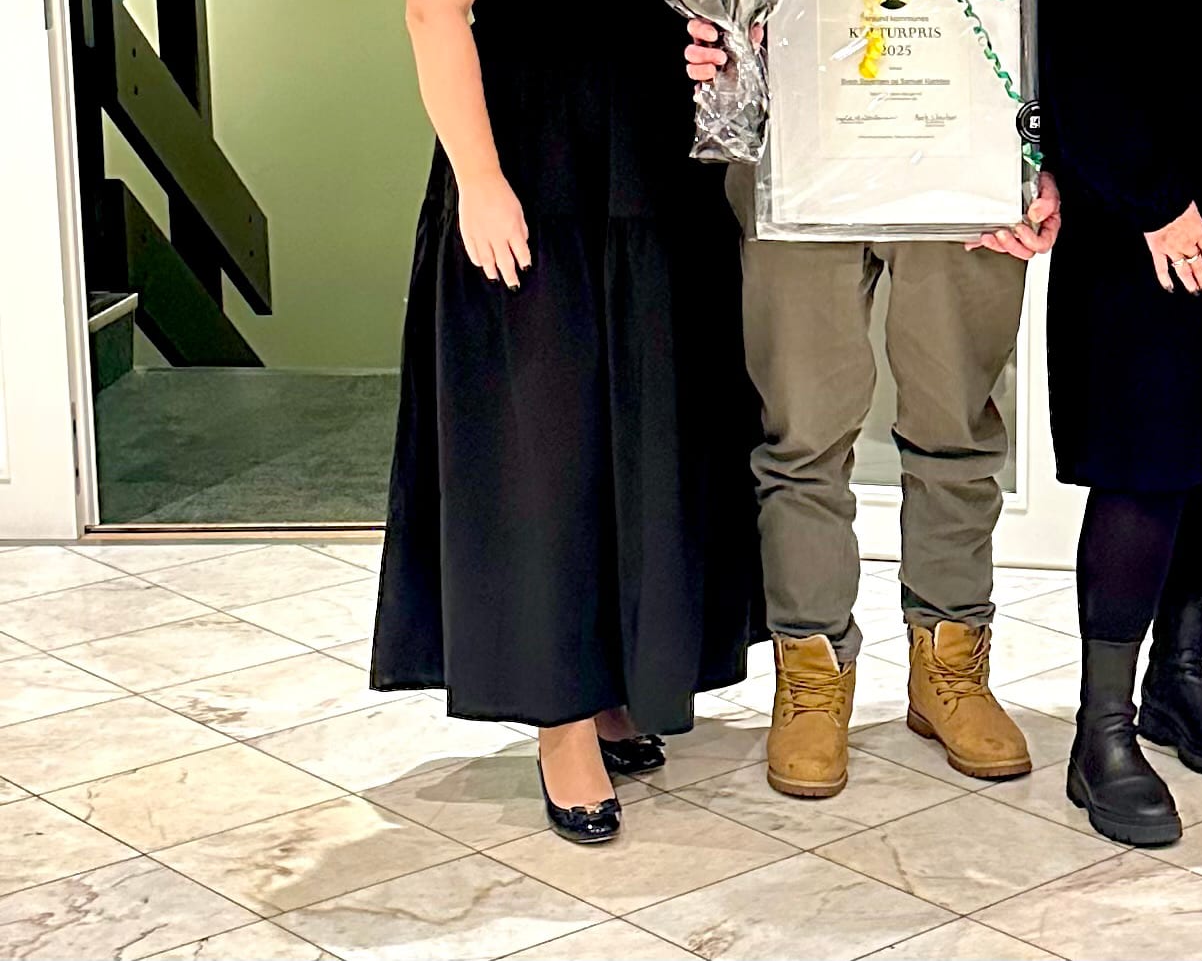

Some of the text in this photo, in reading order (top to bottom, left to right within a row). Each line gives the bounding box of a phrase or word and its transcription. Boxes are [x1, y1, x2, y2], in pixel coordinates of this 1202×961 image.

[890, 15, 929, 23] kommunes
[849, 26, 942, 39] KTURPRIS
[881, 44, 912, 56] 2025
